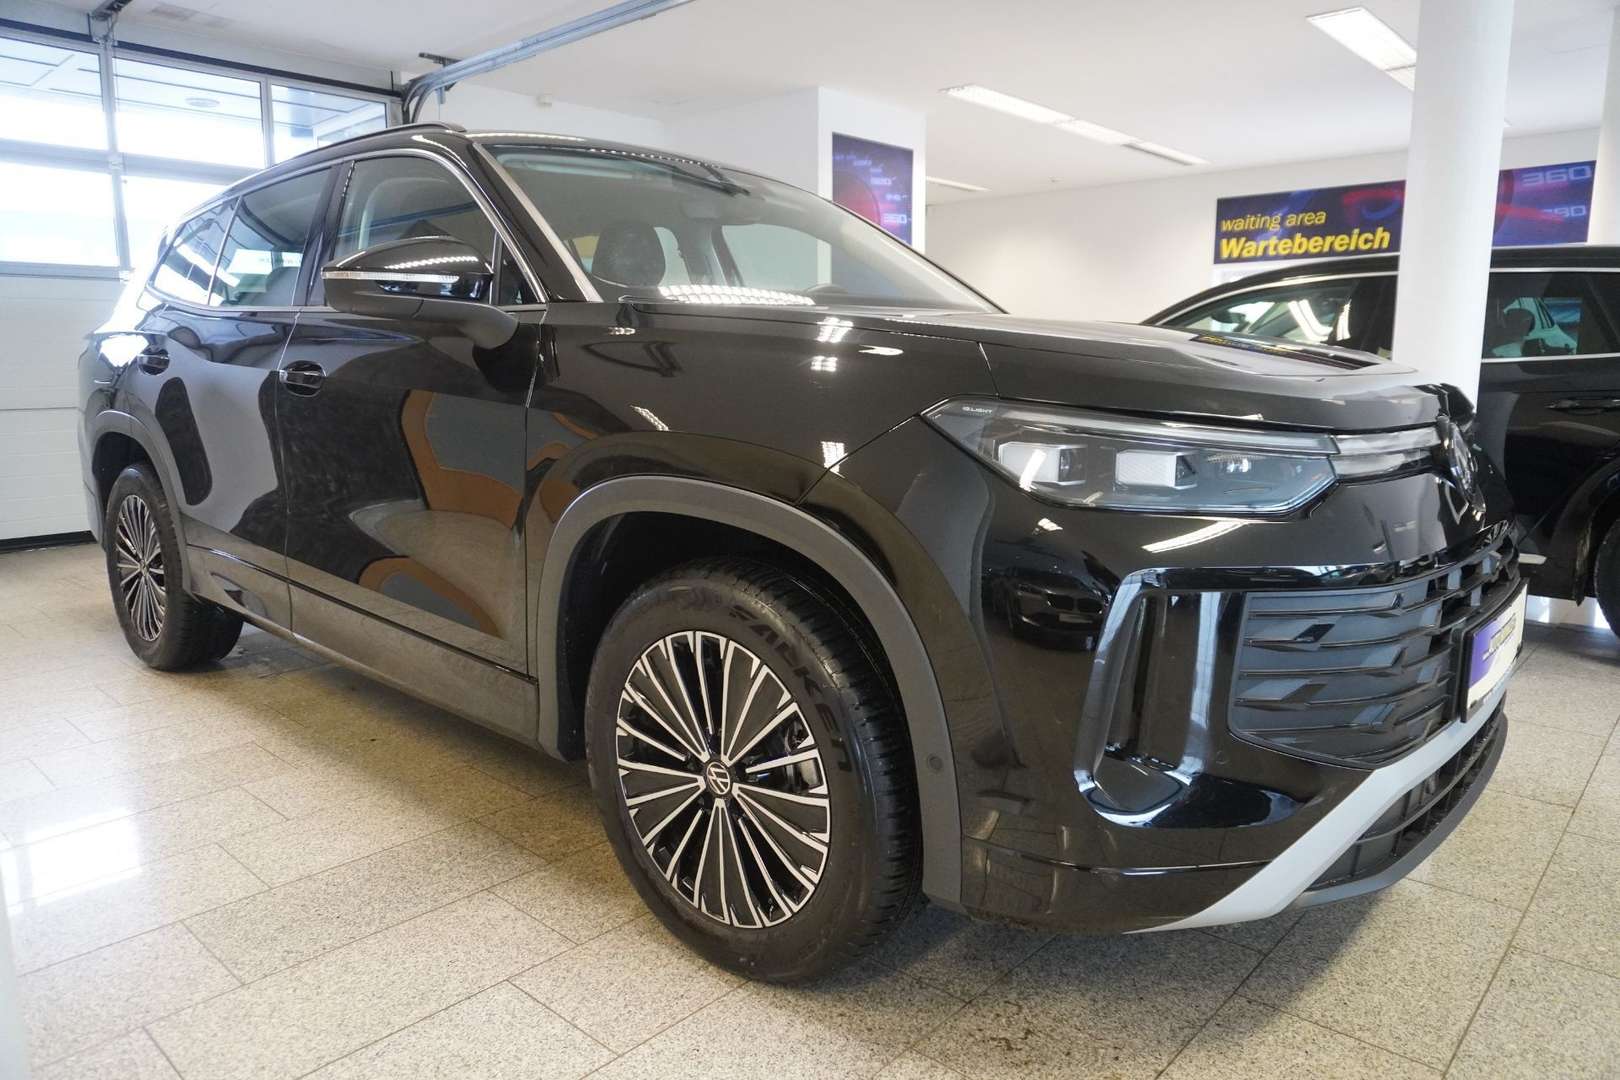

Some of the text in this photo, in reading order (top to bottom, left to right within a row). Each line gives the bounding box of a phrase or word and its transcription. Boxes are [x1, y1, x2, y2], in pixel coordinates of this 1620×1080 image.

[1520, 165, 1592, 187] 360
[1220, 210, 1327, 232] waiting area
[1220, 227, 1392, 259] Wartebereich
